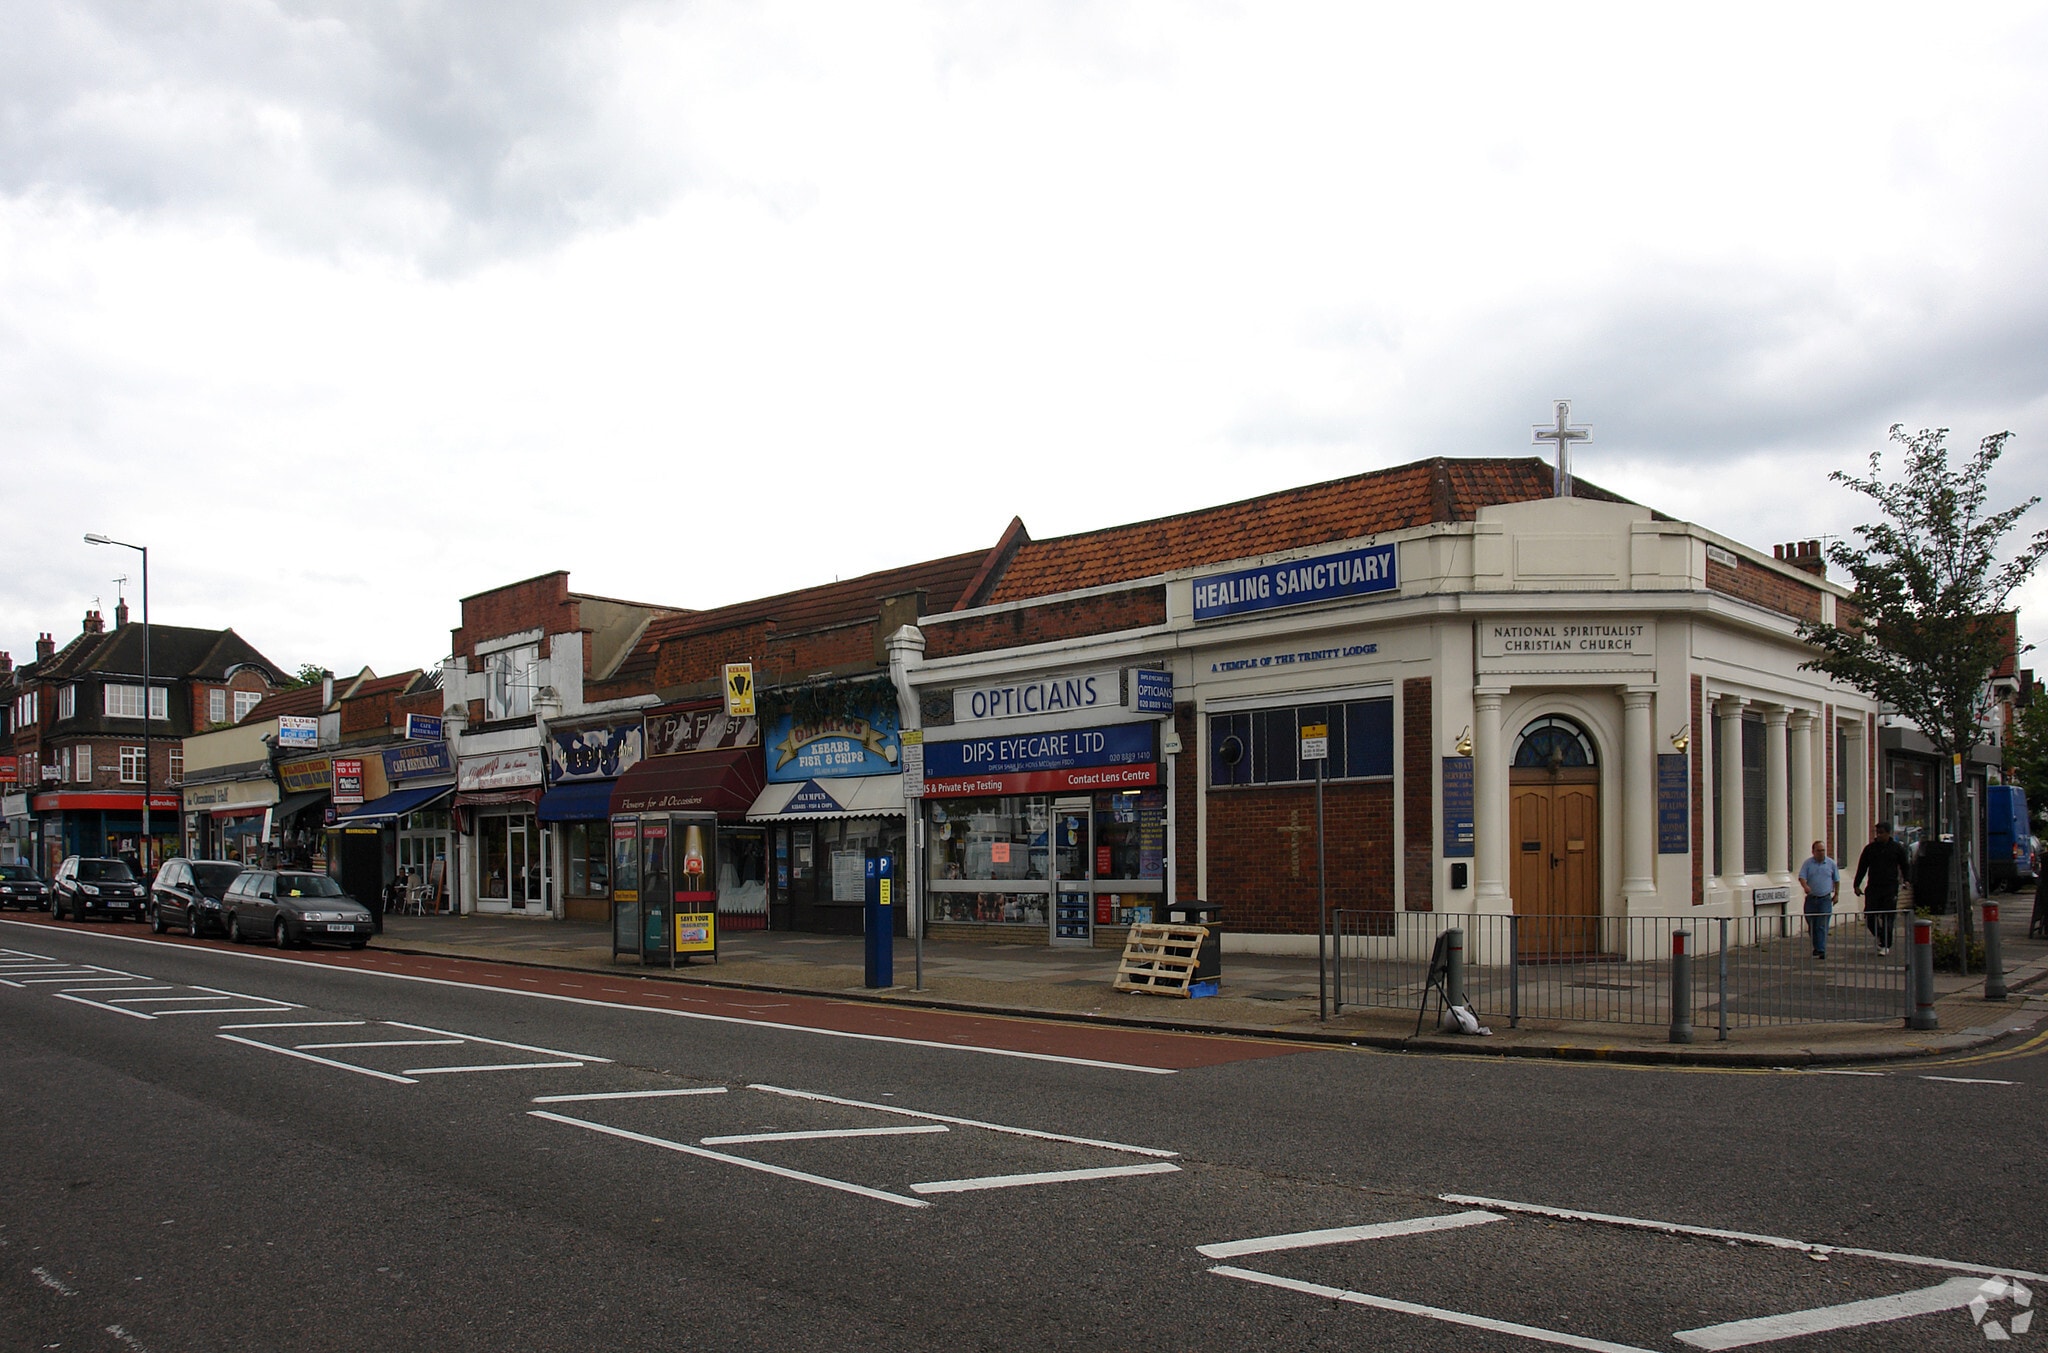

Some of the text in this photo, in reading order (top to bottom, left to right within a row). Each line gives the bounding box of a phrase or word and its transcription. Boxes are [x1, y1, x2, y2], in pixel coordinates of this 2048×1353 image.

[1195, 552, 1391, 609] HEALING SANCTUARY
[1494, 626, 1644, 637] NATIONAL SPIRITUALIST
[1505, 639, 1632, 651] CHRISTIAN CHURCH
[1211, 644, 1378, 673] A TEMPLE OF THE TRINITY LODGE
[971, 677, 1097, 718] OPTICIANS
[1138, 684, 1173, 698] OPTICIANS
[1140, 700, 1148, 708] 020
[794, 718, 864, 742] OLYMPUS
[811, 741, 850, 754] KEBABS
[962, 732, 1104, 763] DIPS EYECARE LTD
[798, 752, 864, 767] FISH & CHIPS
[1109, 752, 1150, 762] 020 8889 1410
[1068, 770, 1150, 786] Contact Lens Centre
[931, 784, 937, 792] &
[938, 782, 961, 793] Private
[962, 781, 975, 793] Eye
[976, 780, 1002, 792] Testing
[622, 800, 646, 809] Flowers
[646, 796, 657, 810] for
[658, 796, 668, 807] all
[867, 861, 874, 872] P
[880, 858, 888, 872] P
